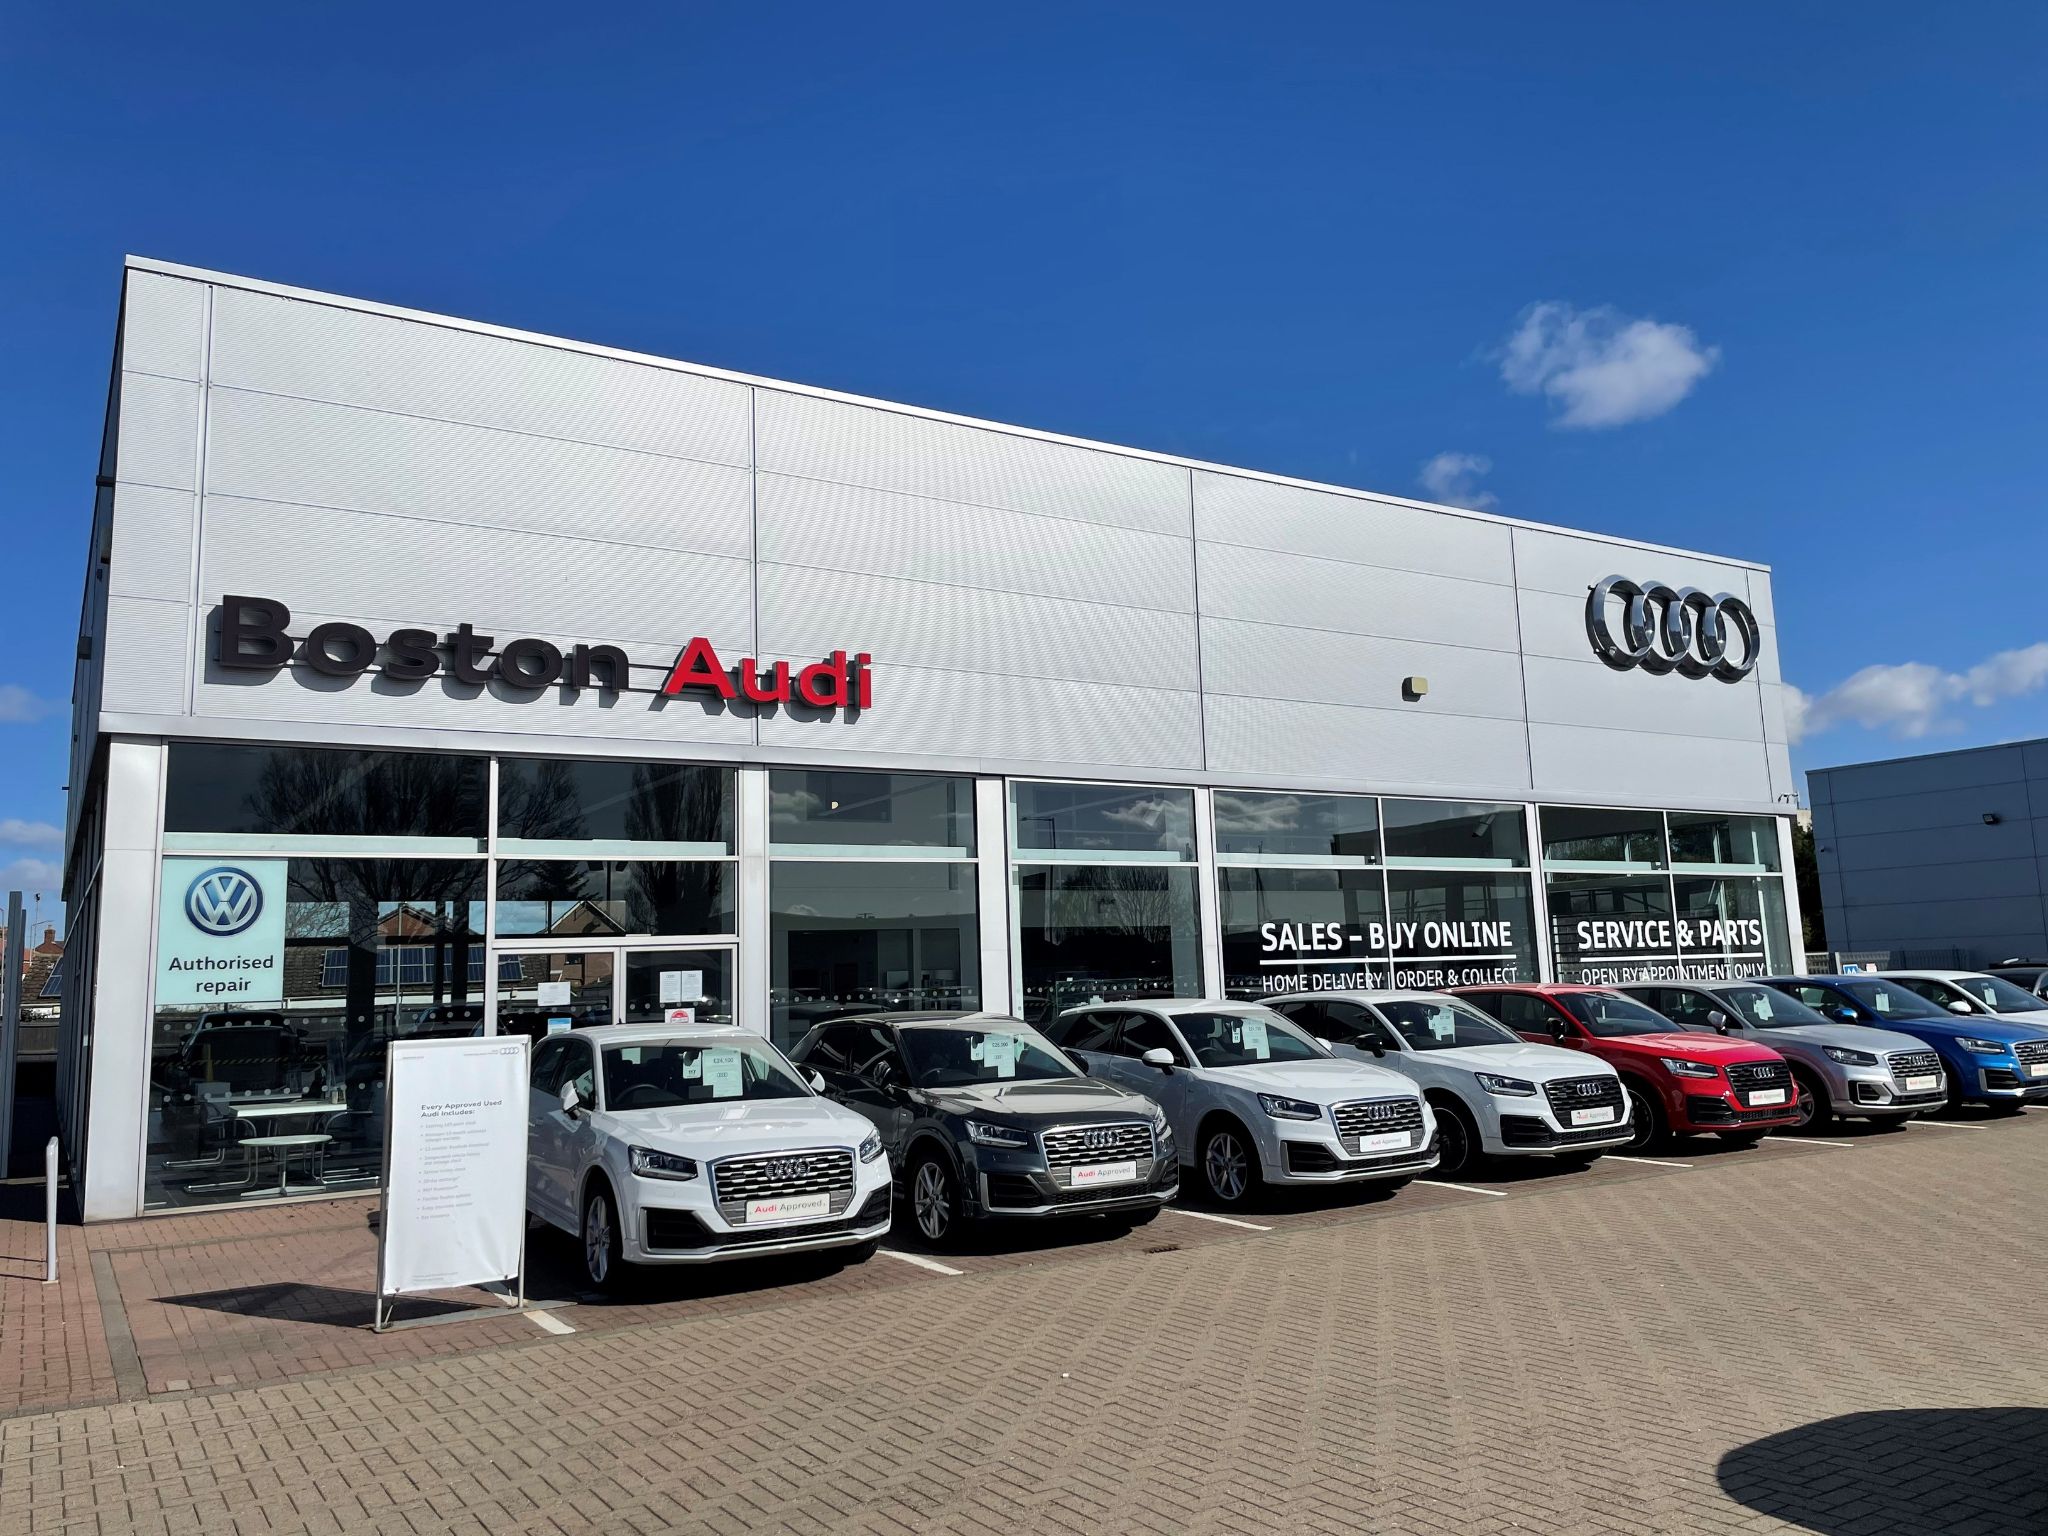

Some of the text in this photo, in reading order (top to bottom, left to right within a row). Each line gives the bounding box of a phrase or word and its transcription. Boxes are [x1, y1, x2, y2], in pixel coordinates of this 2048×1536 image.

[219, 594, 872, 710] Boston Audi
[1261, 922, 1343, 951] SALES
[1369, 922, 1417, 950] BUY
[1424, 921, 1513, 949] ONLINE
[1577, 919, 1762, 949] SERVICE & PARTS
[168, 955, 274, 971] Authorised
[1262, 974, 1309, 992] HOME
[1312, 972, 1382, 991] DELIVERY
[1396, 970, 1444, 988] ORDER
[1447, 969, 1459, 986] &
[1462, 967, 1517, 985] COLLECT
[1581, 968, 1619, 985] OPEN
[1642, 964, 1731, 982] APPOINTMENT
[1734, 963, 1764, 980] ONLY
[195, 977, 252, 996] repair
[445, 1101, 482, 1109] Approved
[1077, 1166, 1131, 1178] Audi Approved
[754, 1200, 822, 1213] Audi Approved
